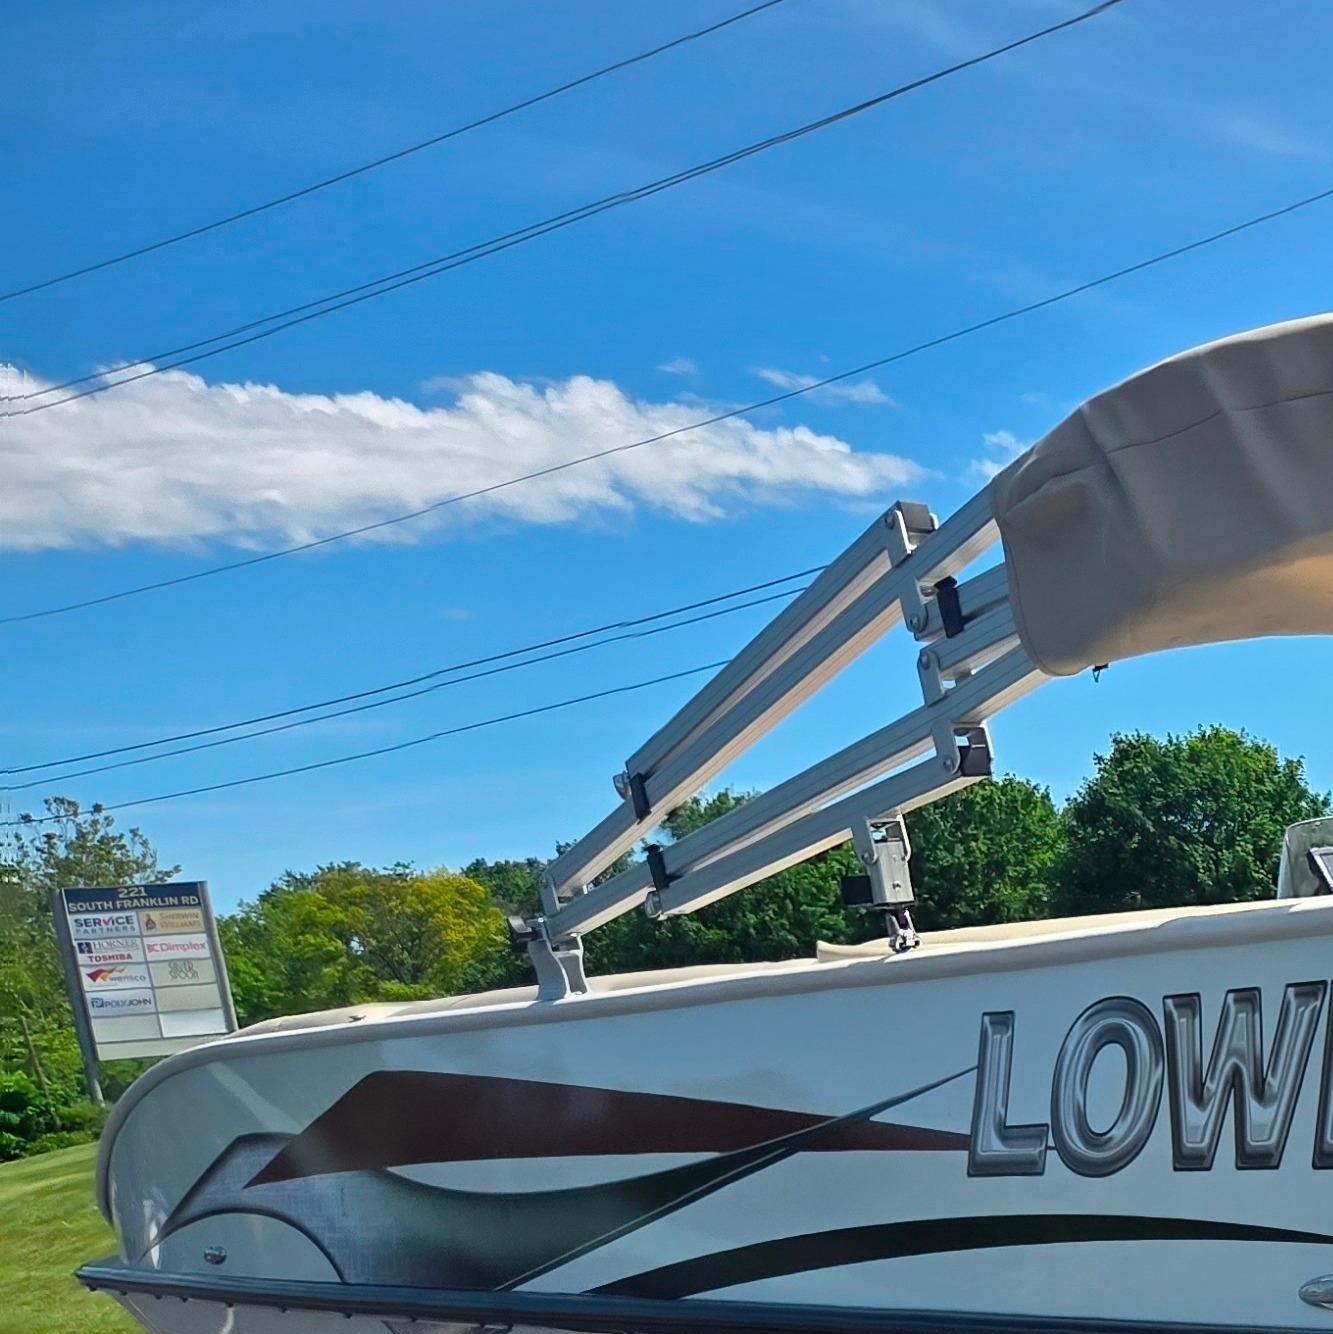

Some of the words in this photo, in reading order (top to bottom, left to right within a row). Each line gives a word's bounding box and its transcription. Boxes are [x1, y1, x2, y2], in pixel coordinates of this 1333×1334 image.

[117, 886, 148, 899] 221
[68, 900, 113, 913] SOUTH
[116, 896, 179, 909] FRANKLIN
[181, 895, 199, 905] RD
[75, 925, 136, 934] PARTNERS
[159, 942, 206, 953] Dimplex
[88, 952, 133, 963] TOSHIBA
